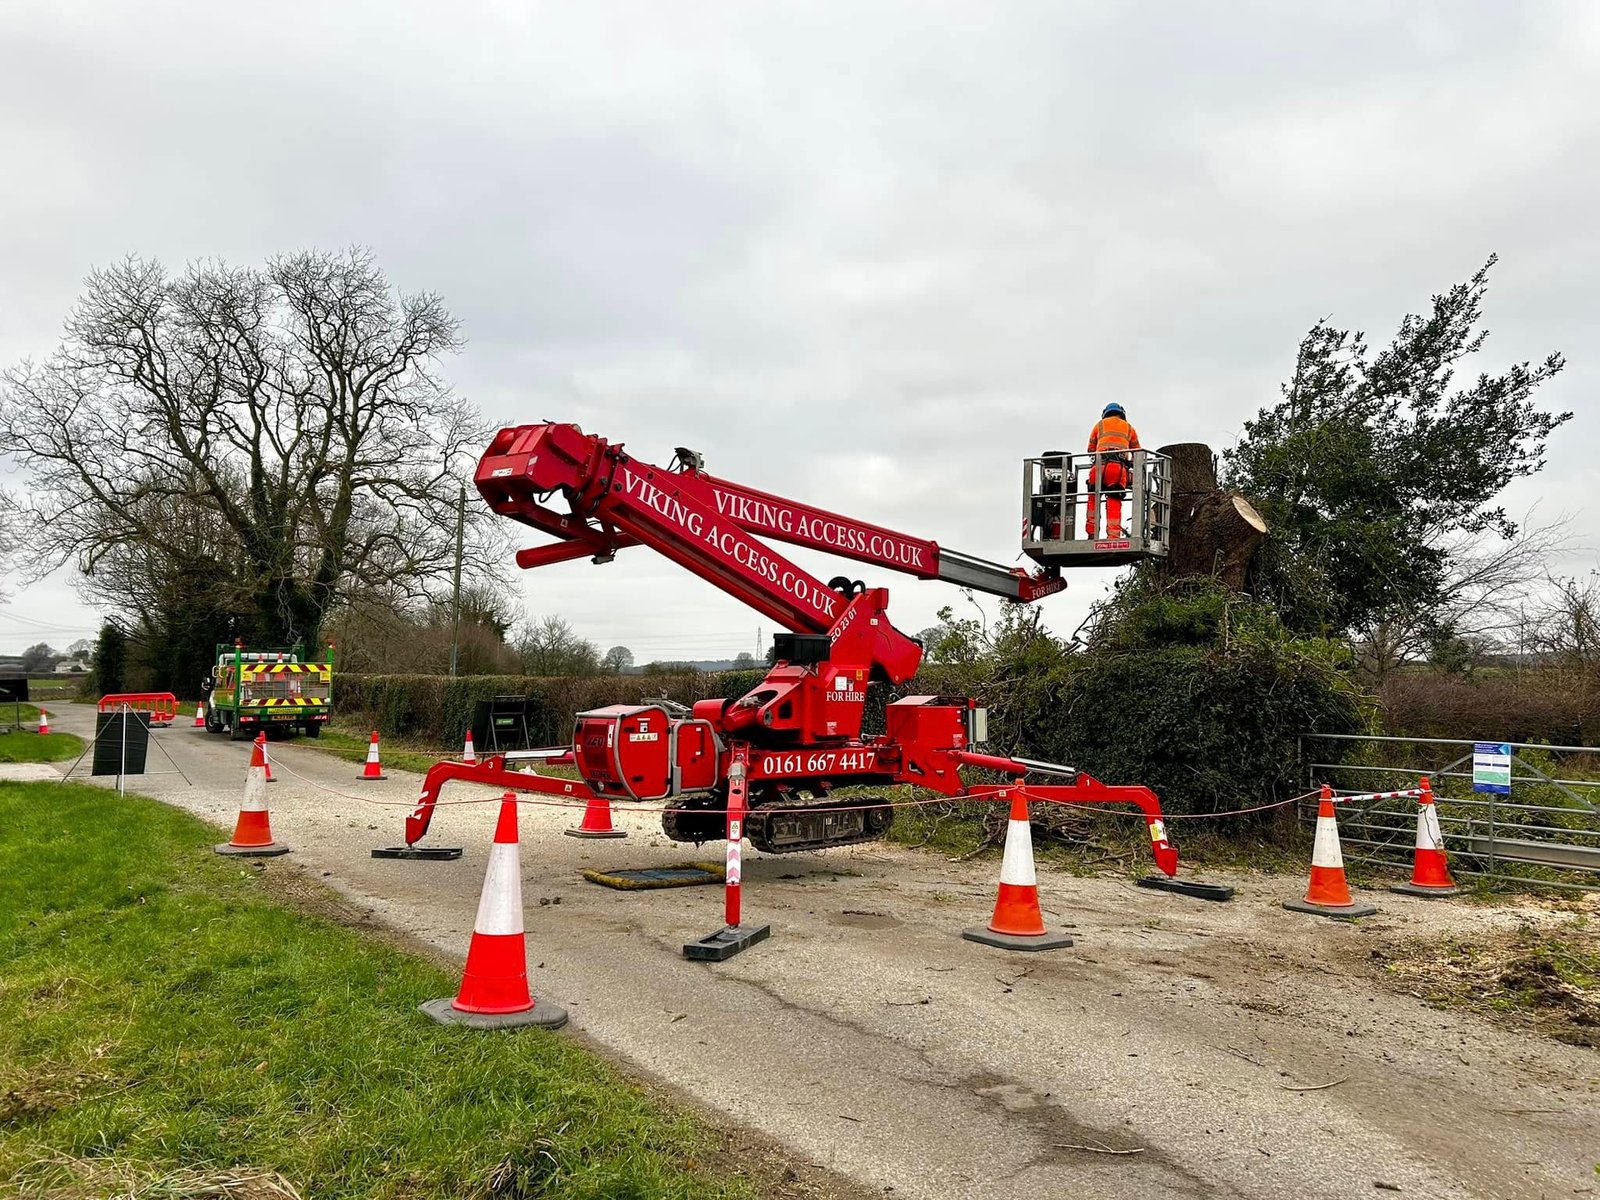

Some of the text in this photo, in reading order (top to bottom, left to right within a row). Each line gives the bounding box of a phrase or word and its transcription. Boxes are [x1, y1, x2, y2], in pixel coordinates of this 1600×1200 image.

[712, 489, 923, 568] VIKING ACCESS.CO.UK
[623, 467, 837, 619] VIKING ACCESS.CO.UK
[1032, 580, 1061, 599] FOR HIRE
[829, 627, 842, 648] EO
[840, 616, 850, 631] 23
[826, 691, 865, 702] FOR HIRE
[763, 752, 875, 775] 0161 667 4417
